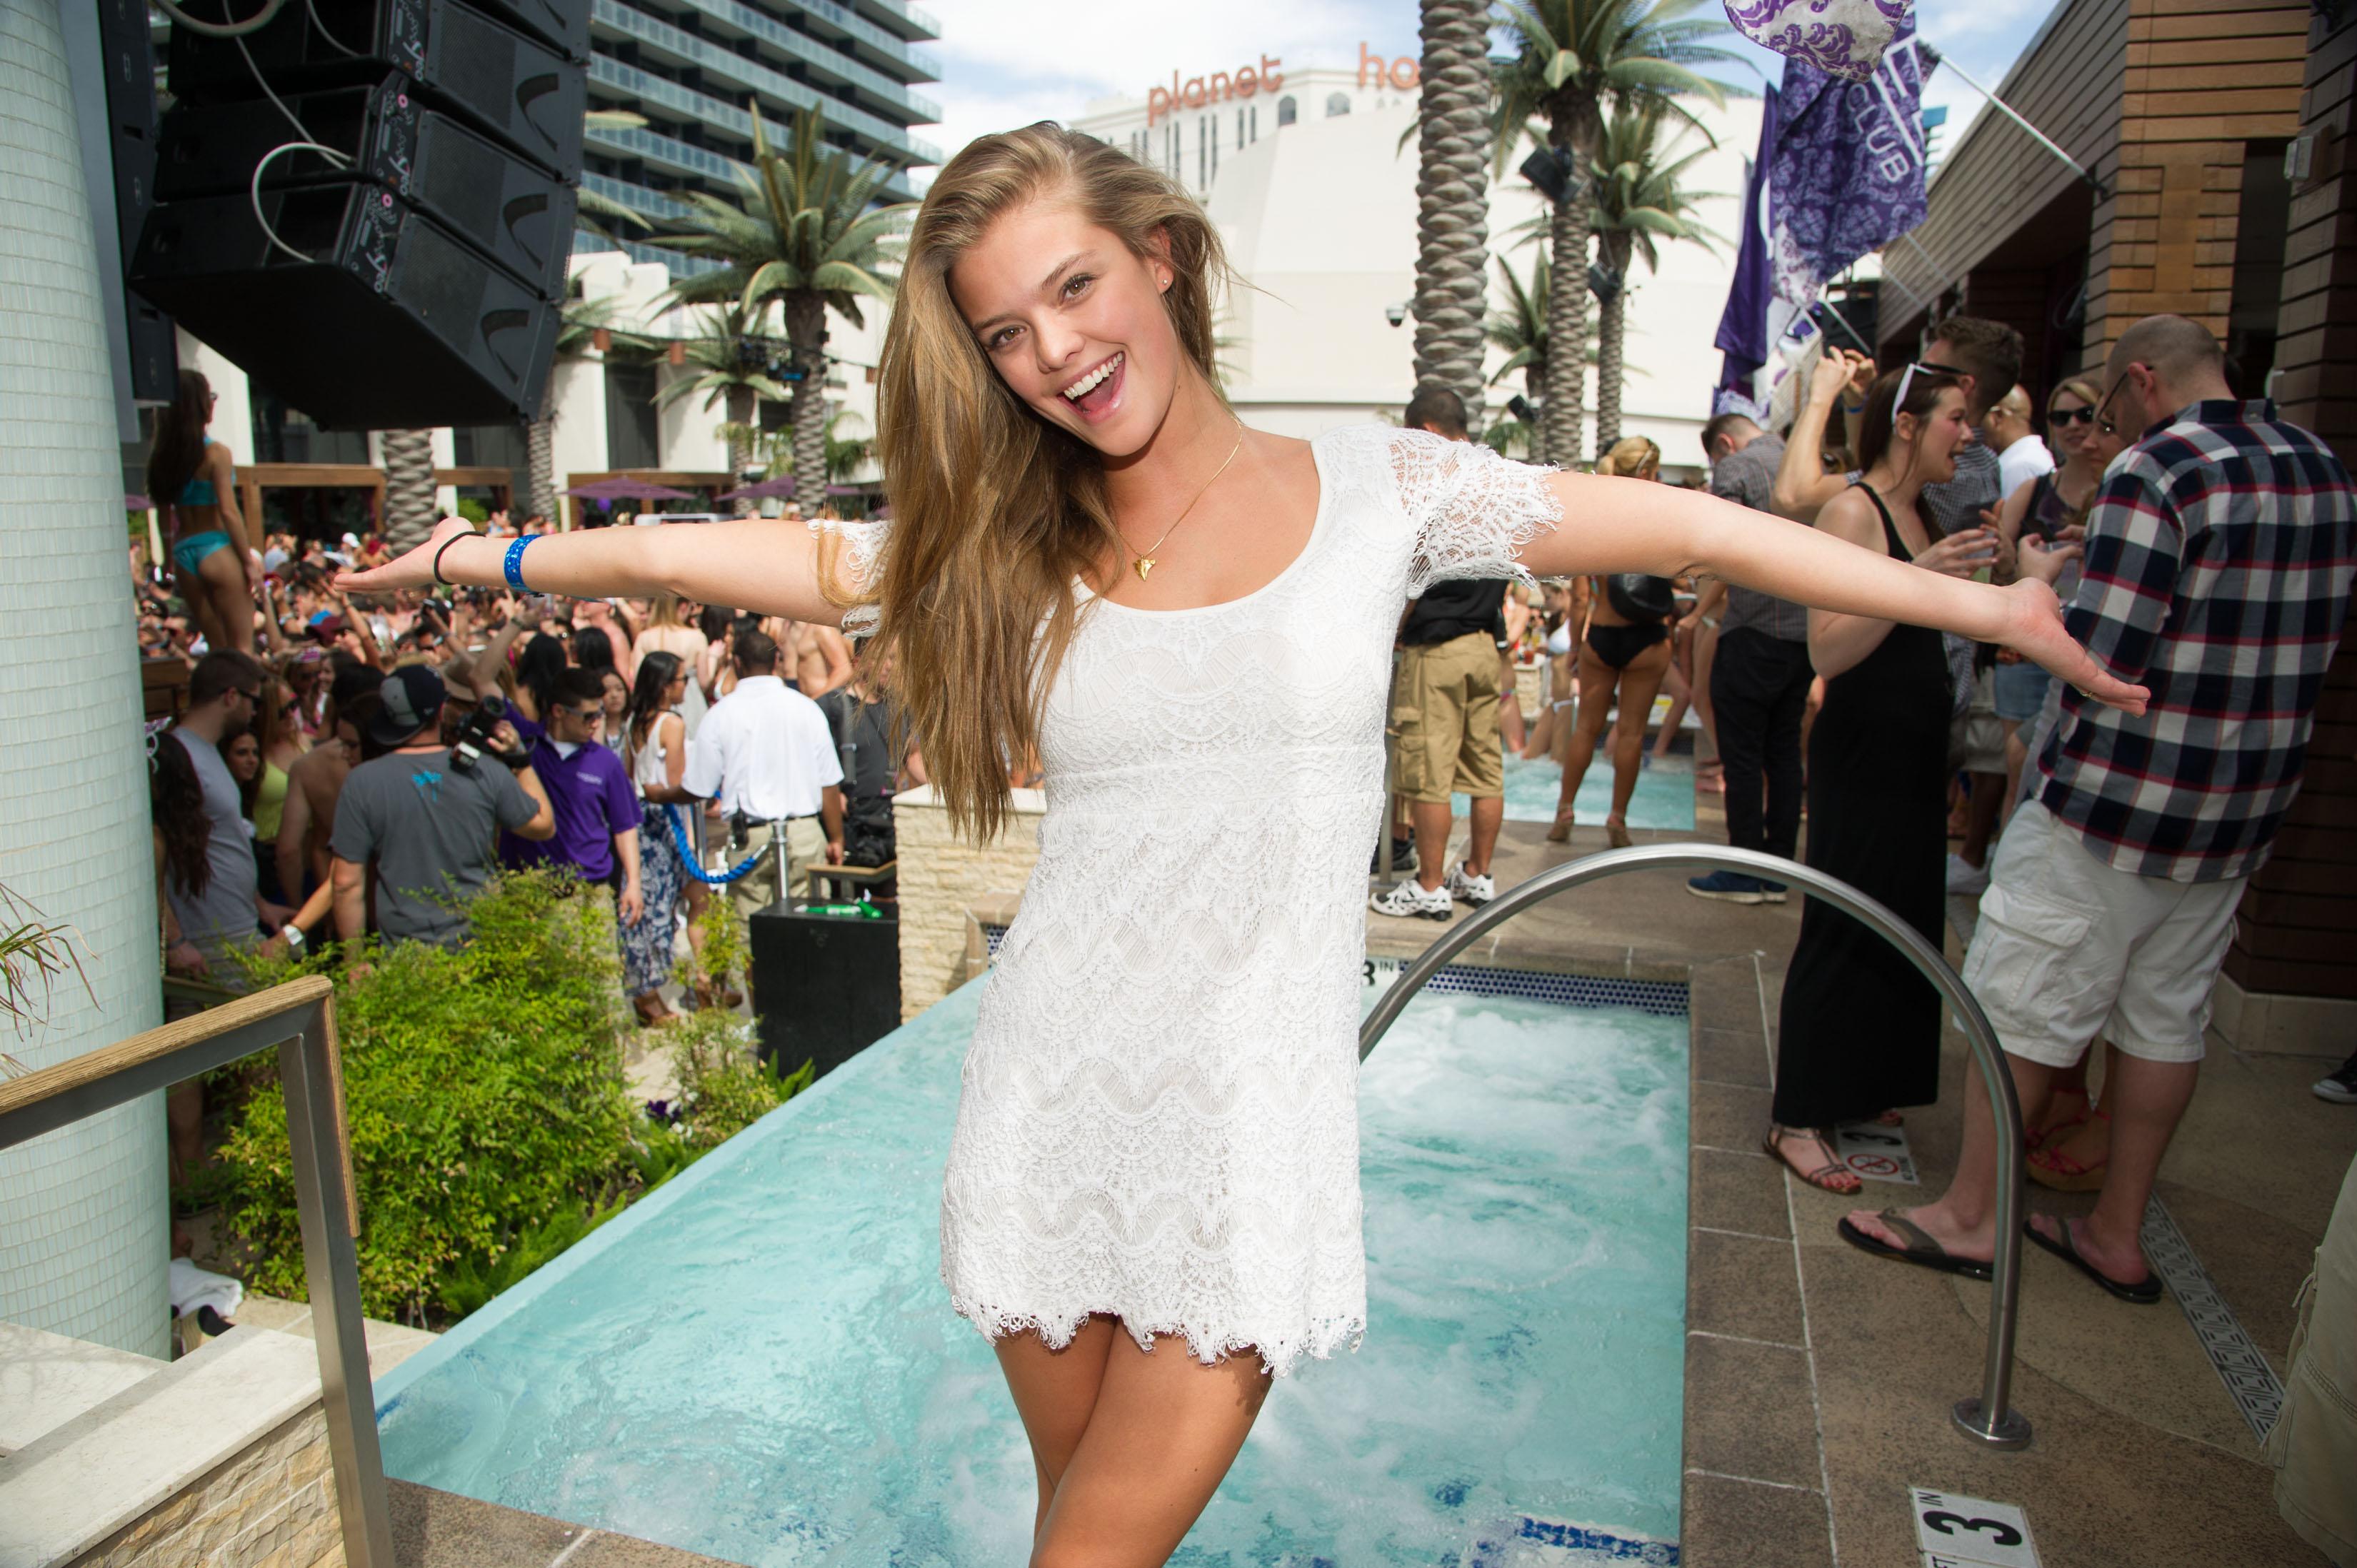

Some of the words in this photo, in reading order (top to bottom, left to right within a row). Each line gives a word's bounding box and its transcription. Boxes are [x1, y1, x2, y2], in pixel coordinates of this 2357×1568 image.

[1148, 53, 1284, 127] planet
[1846, 83, 1911, 183] CLUB
[1379, 960, 1393, 972] IN
[1917, 1491, 1943, 1507] IN
[1923, 1510, 2023, 1546] 3
